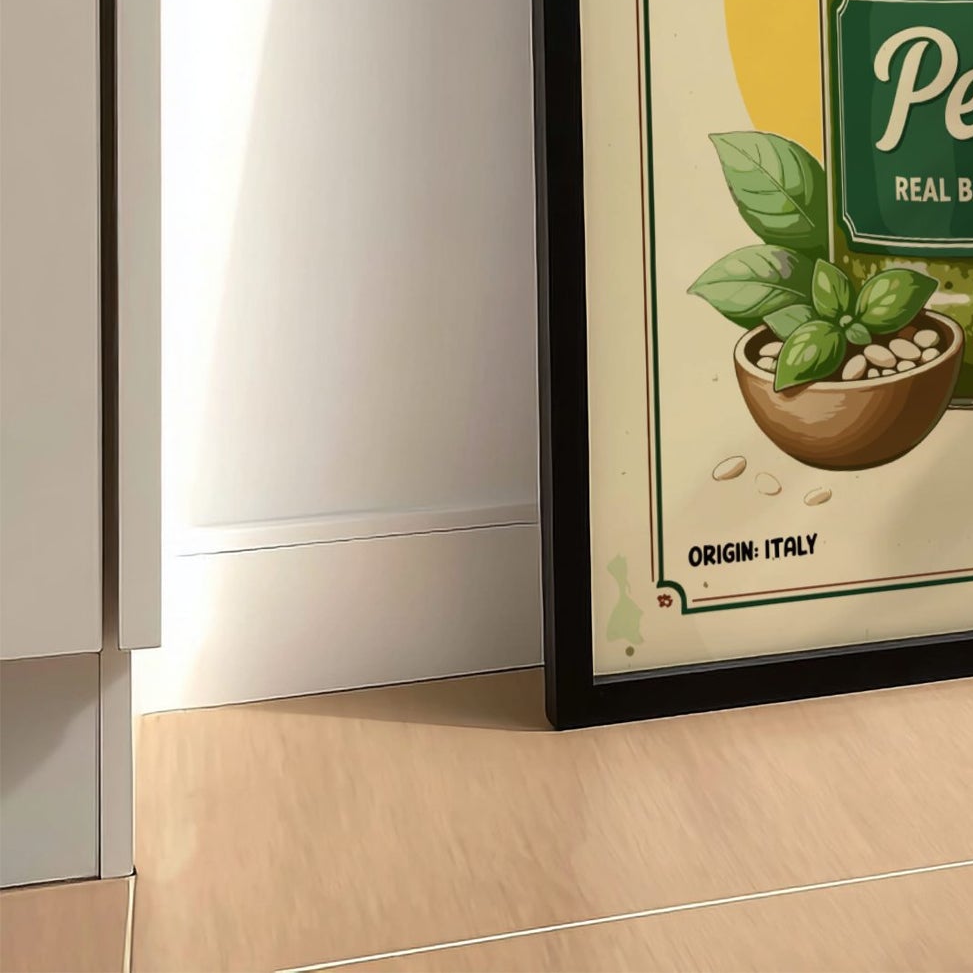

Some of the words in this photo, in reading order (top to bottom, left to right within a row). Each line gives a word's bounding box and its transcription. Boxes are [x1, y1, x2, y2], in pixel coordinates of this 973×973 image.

[895, 176, 951, 203] REAL
[688, 540, 759, 567] ORIGIN:
[764, 533, 818, 560] ITALY
